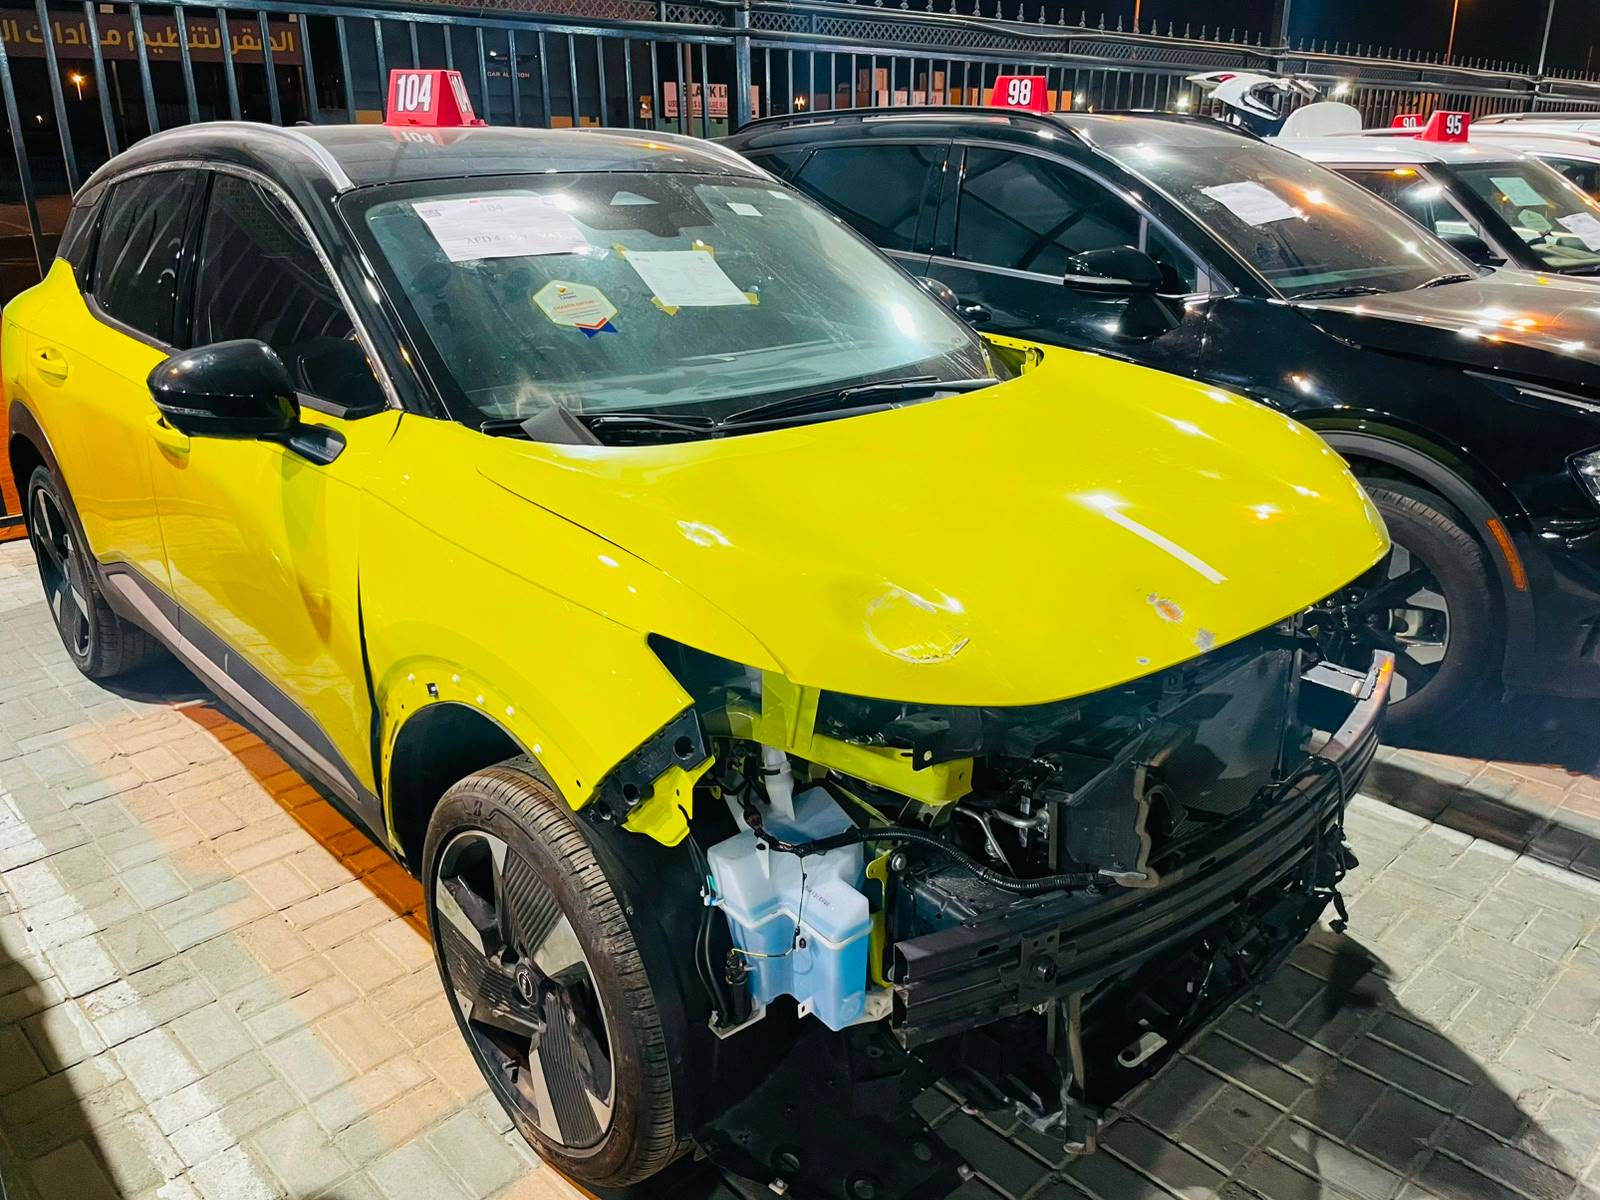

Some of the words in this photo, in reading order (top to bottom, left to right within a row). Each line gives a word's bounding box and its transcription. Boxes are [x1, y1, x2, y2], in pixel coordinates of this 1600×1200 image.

[24, 21, 121, 47] مادات
[397, 73, 432, 112] 104
[1007, 79, 1032, 105] 98
[1446, 114, 1463, 135] 95
